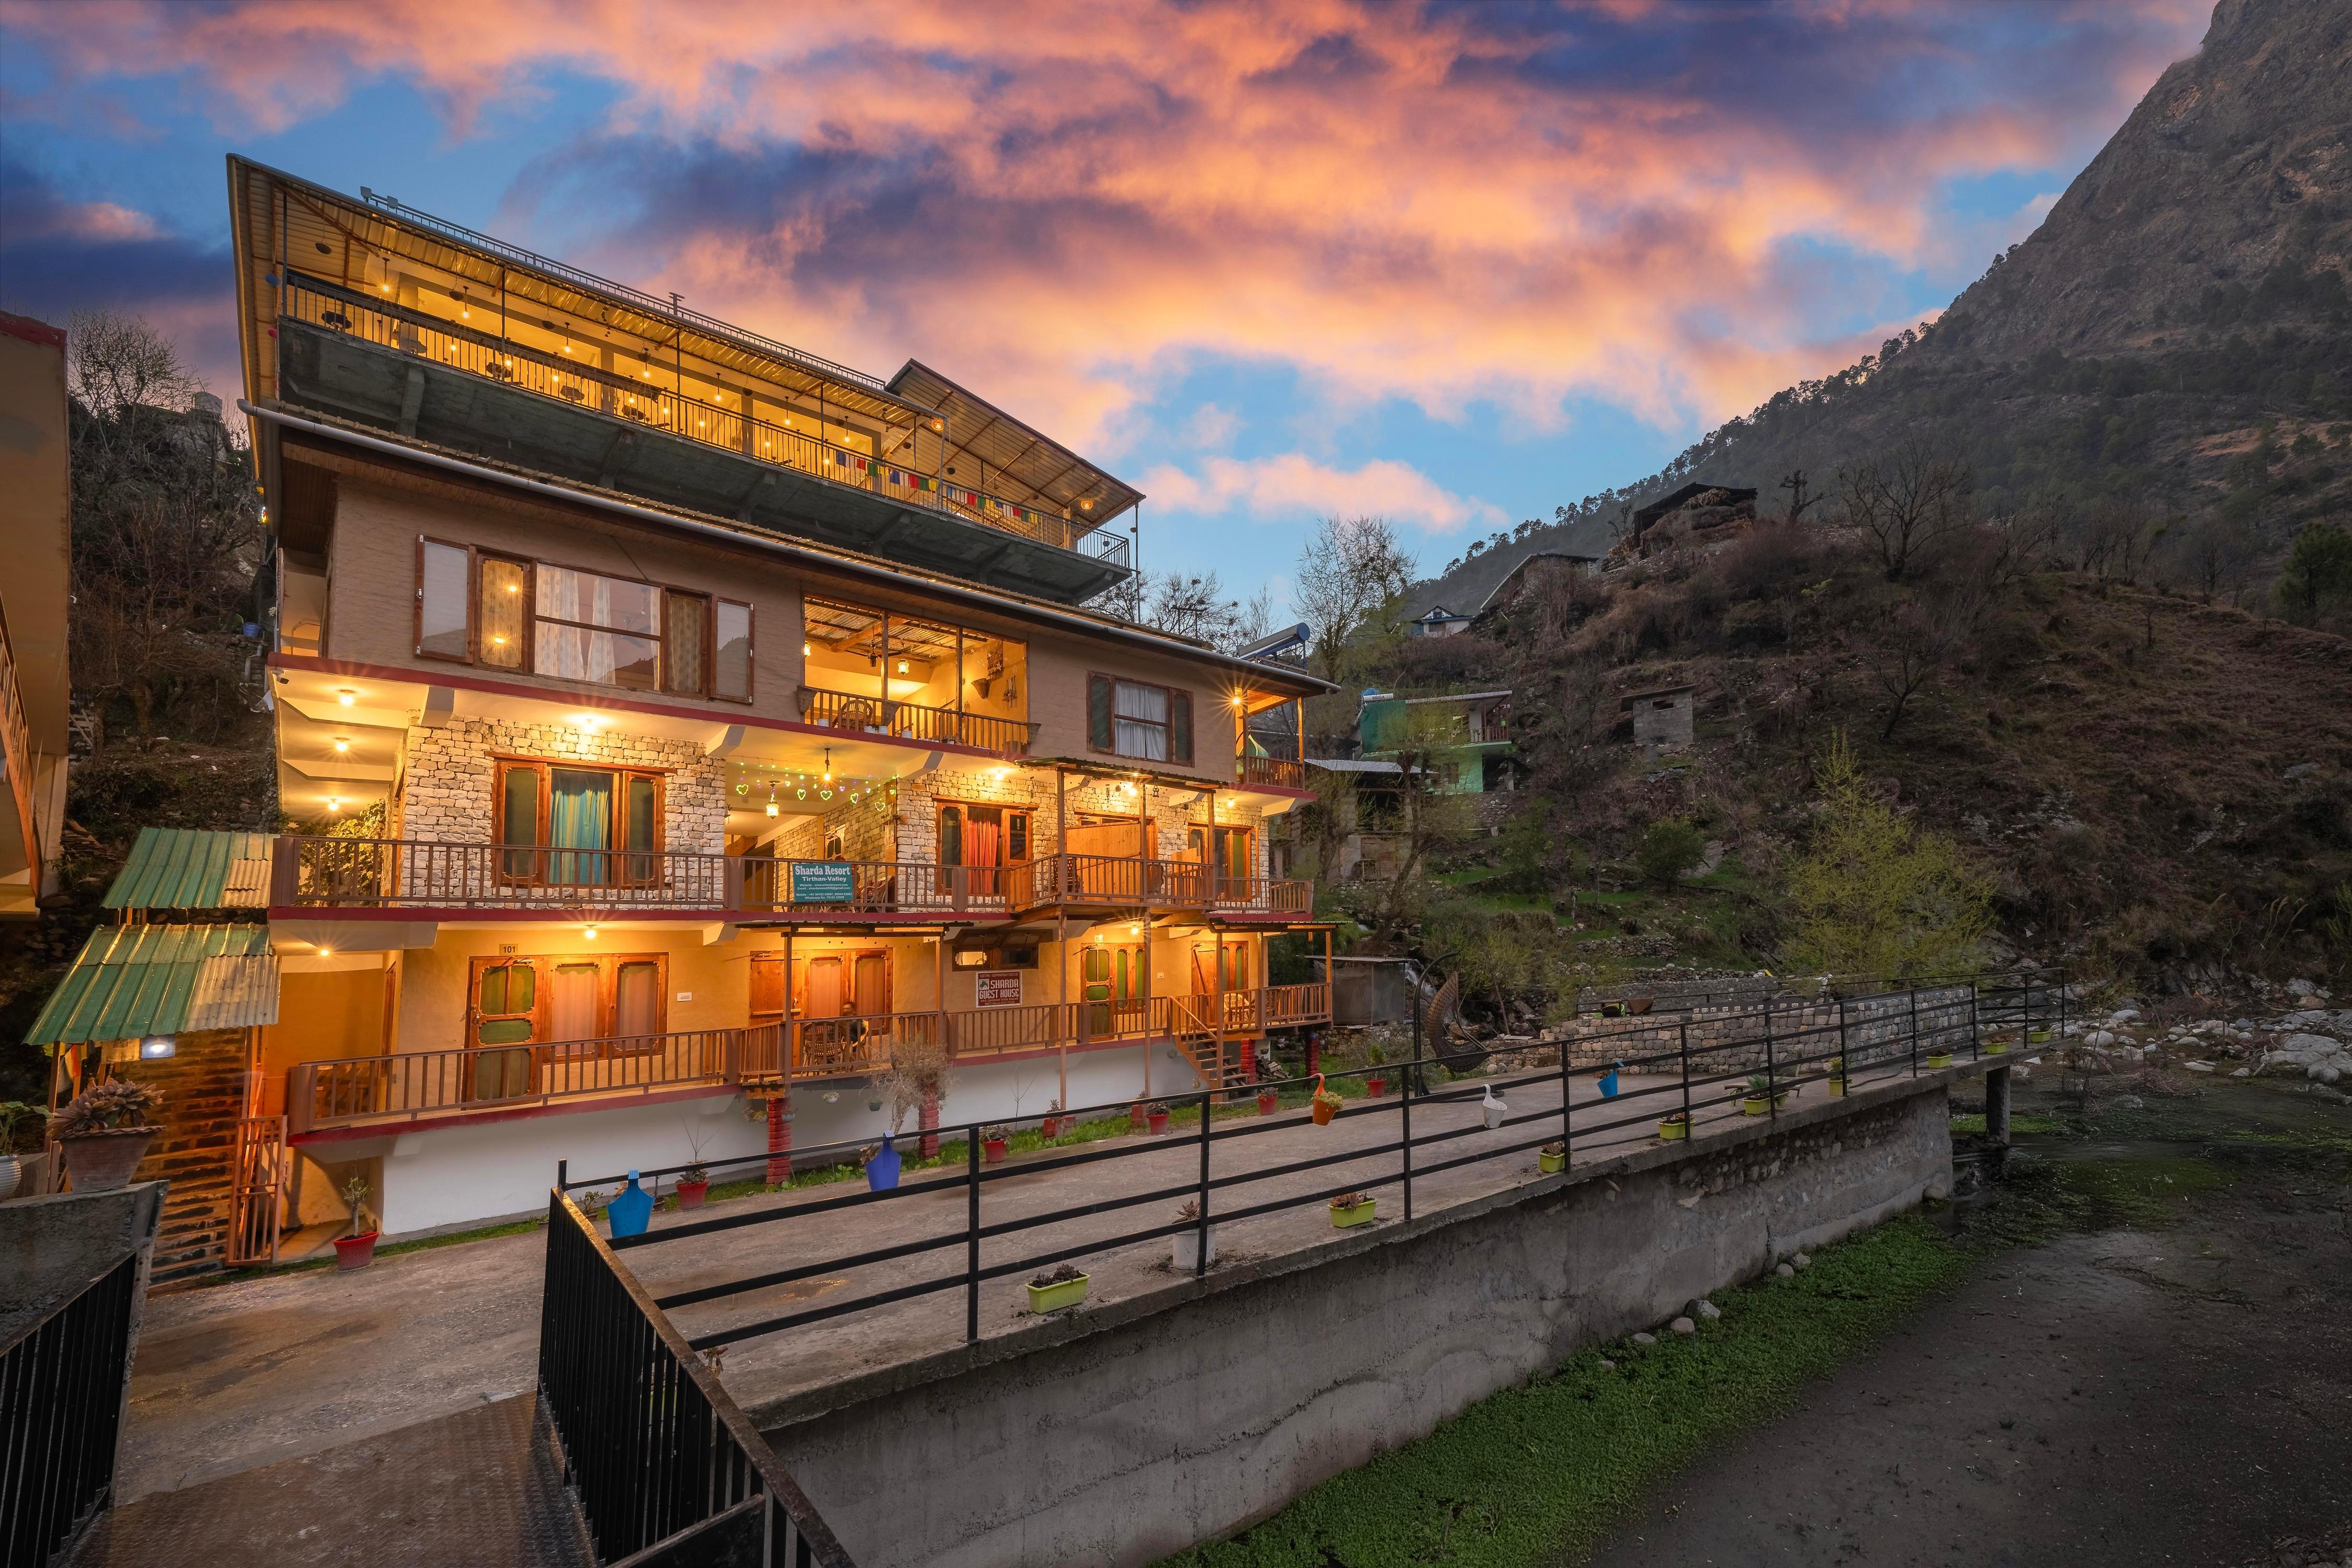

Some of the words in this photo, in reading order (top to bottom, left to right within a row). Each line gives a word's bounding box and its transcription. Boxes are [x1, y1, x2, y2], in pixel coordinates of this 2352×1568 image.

[795, 865, 823, 875] Sharda
[825, 865, 850, 875] Resort
[990, 979, 1019, 989] SHARDA
[979, 990, 998, 999] GUEST
[1000, 989, 1019, 998] HOUSE
